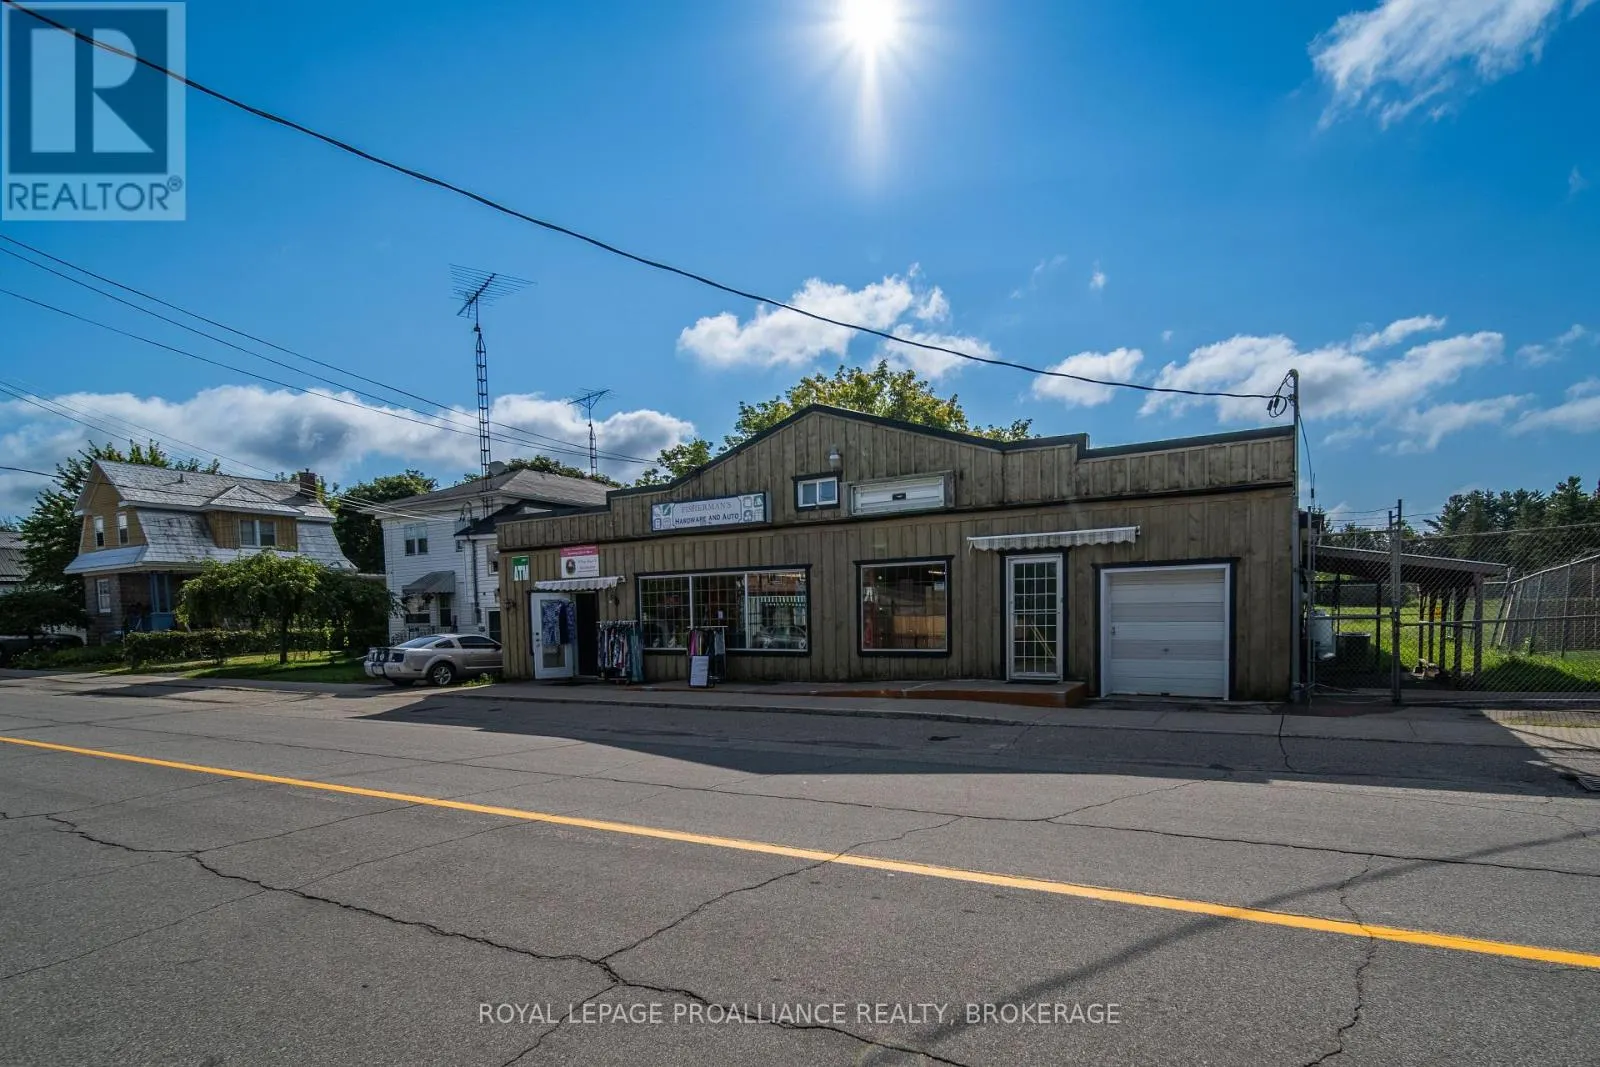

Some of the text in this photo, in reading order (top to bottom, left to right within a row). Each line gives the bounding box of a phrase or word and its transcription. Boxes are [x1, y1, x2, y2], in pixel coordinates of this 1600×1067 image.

[680, 501, 732, 513] FISHERMAN'S
[675, 515, 706, 525] HARDWARE
[722, 512, 740, 521] AUTO
[513, 564, 529, 582] ATM
